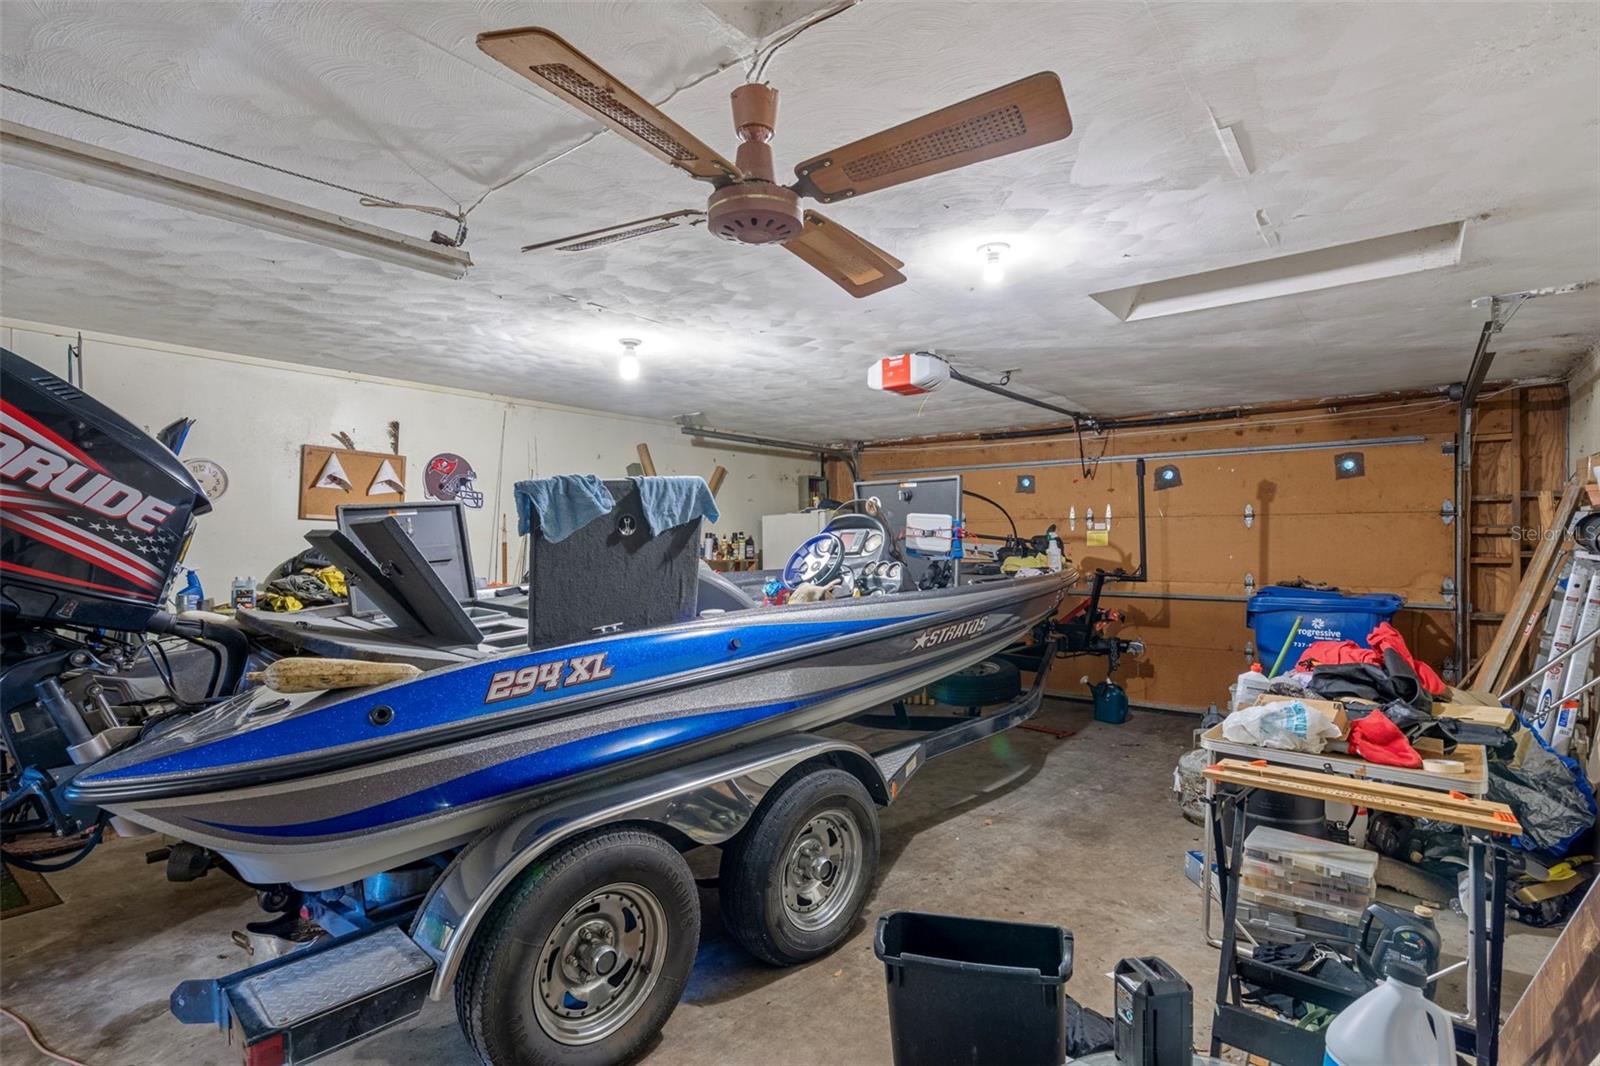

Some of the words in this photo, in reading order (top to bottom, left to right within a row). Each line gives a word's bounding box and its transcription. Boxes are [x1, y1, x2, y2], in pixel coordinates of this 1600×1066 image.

[926, 615, 989, 647] STRATOS
[1298, 629, 1341, 637] rogressive
[484, 661, 564, 704] 294
[563, 651, 615, 688] XL
